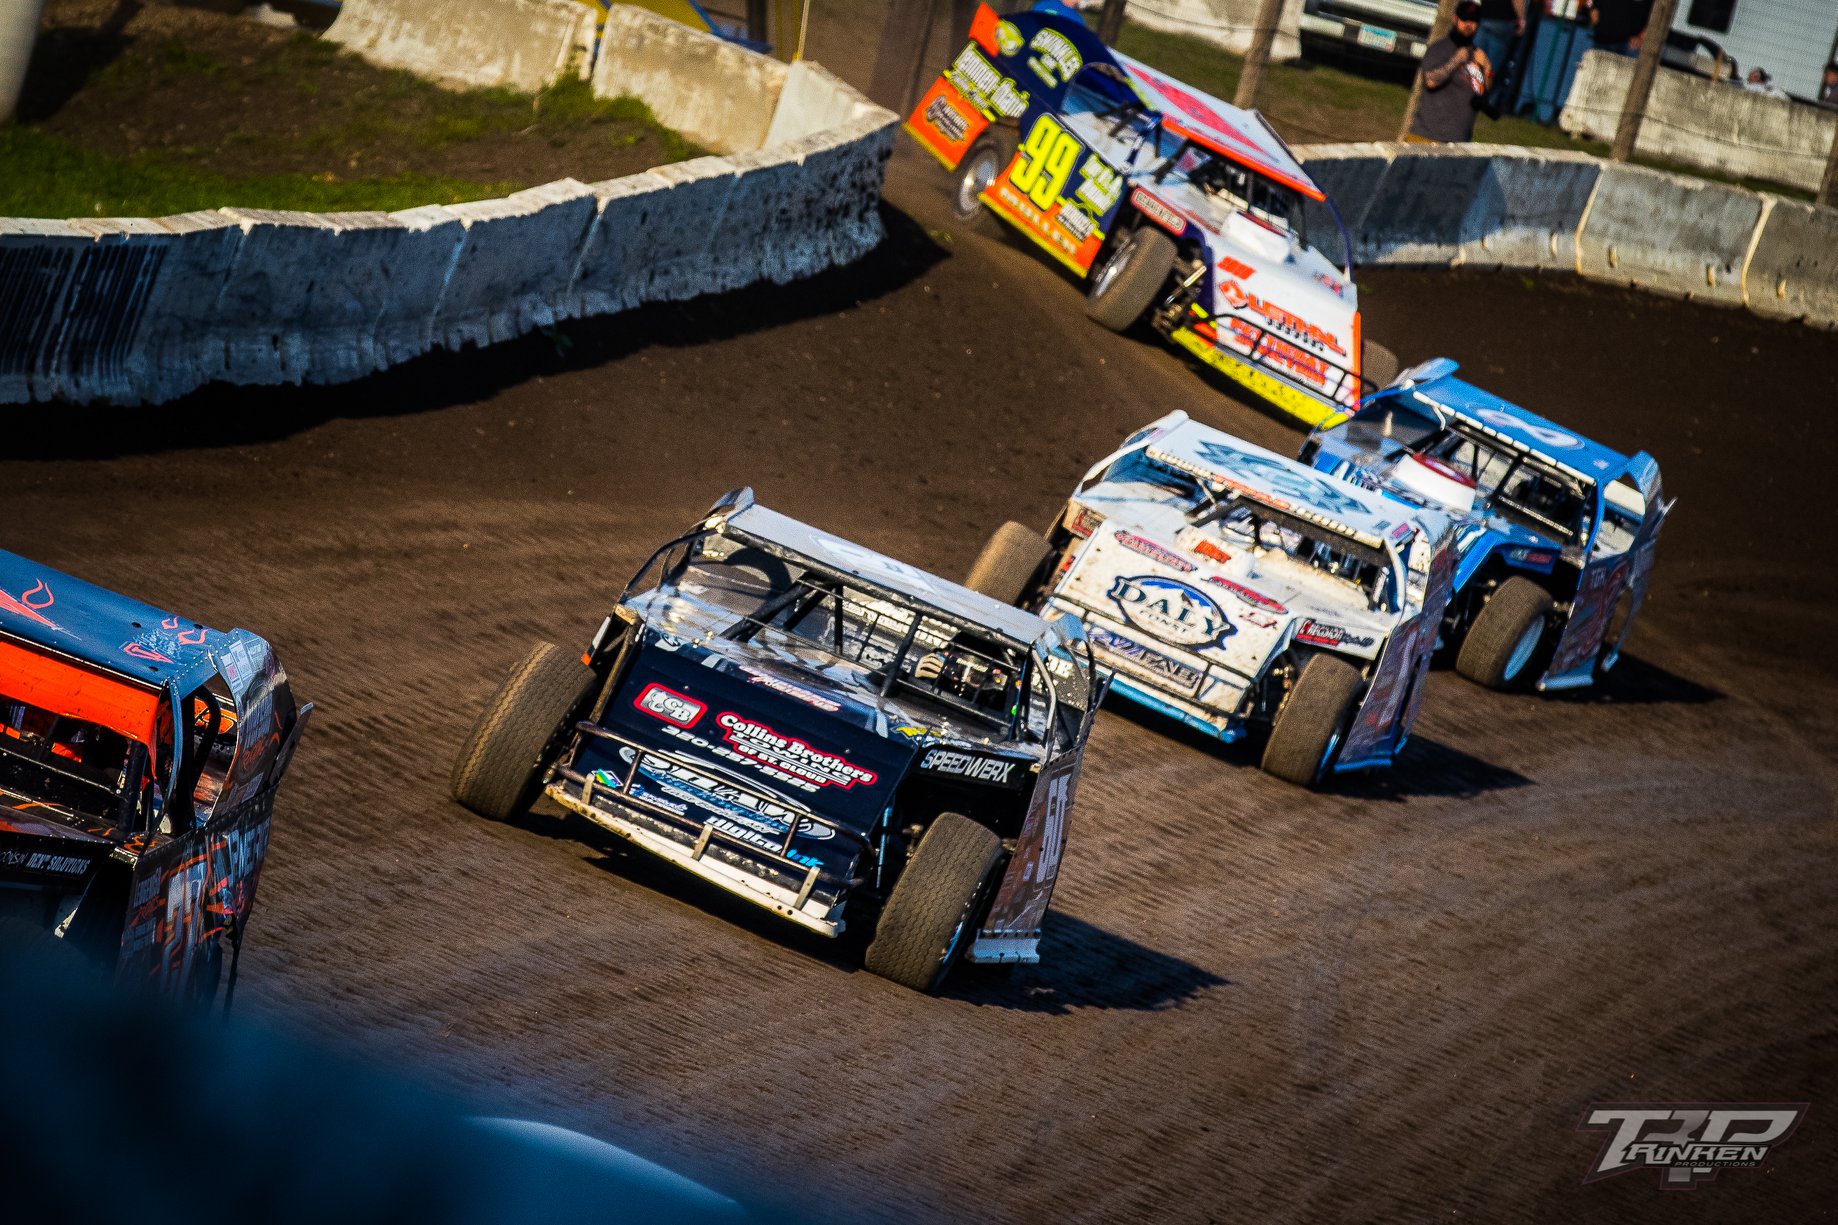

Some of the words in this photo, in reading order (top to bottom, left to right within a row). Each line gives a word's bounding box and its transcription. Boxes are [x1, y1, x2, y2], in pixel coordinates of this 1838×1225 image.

[1009, 114, 1083, 211] 99
[1113, 581, 1230, 638] DALY
[720, 714, 787, 749] Collins
[787, 737, 873, 782] Brothers
[920, 749, 1016, 783] SPEEDWERX
